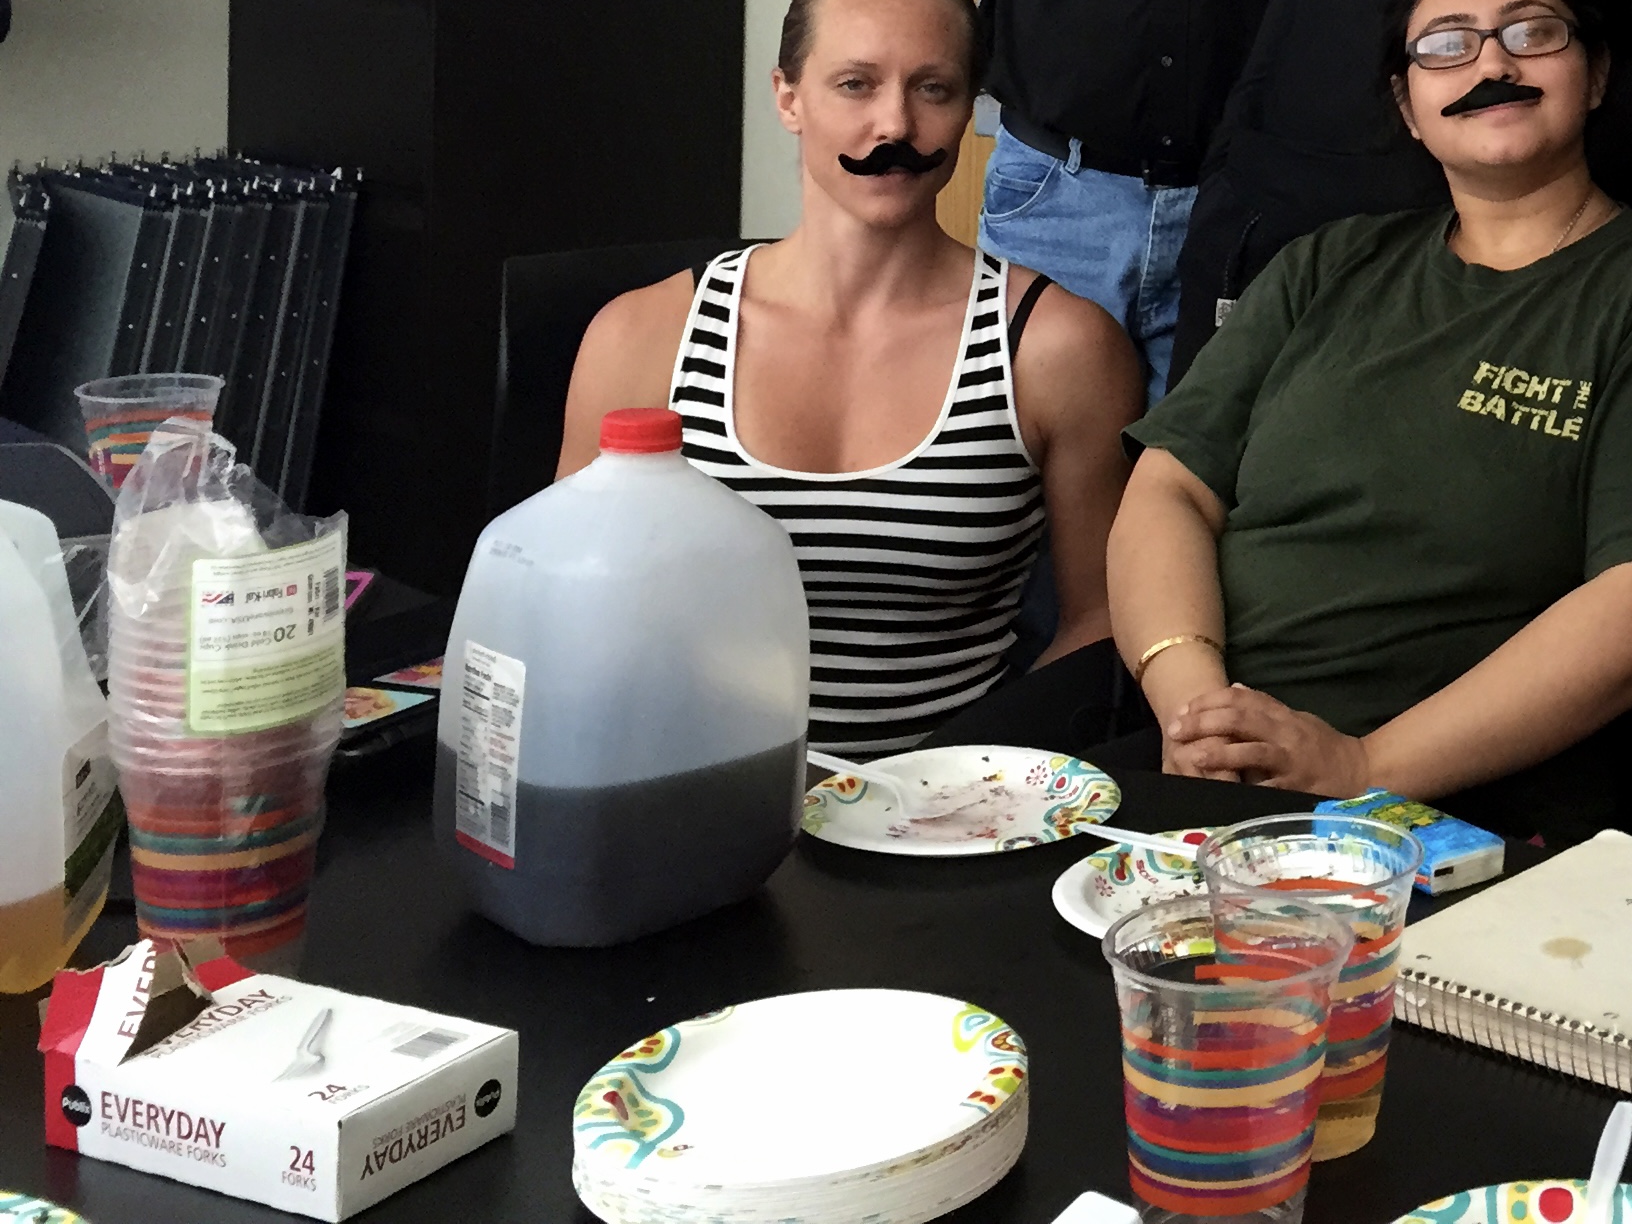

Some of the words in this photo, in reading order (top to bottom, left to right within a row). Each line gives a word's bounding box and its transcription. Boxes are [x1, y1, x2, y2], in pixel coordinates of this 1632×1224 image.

[1472, 360, 1573, 404] FIGHT
[1572, 380, 1593, 410] THE
[1456, 389, 1584, 441] BATTLE
[273, 623, 297, 643] 20
[117, 944, 156, 1038] EVER
[62, 1095, 91, 1114] Publix
[308, 1083, 348, 1102] 24
[101, 1091, 226, 1148] EVERYDAY
[101, 1125, 182, 1157] PLASTICWARE
[187, 1147, 227, 1167] FORKS
[289, 1145, 316, 1175] 24
[360, 1104, 466, 1180] EVERYDAY
[281, 1170, 317, 1192] FORKS
